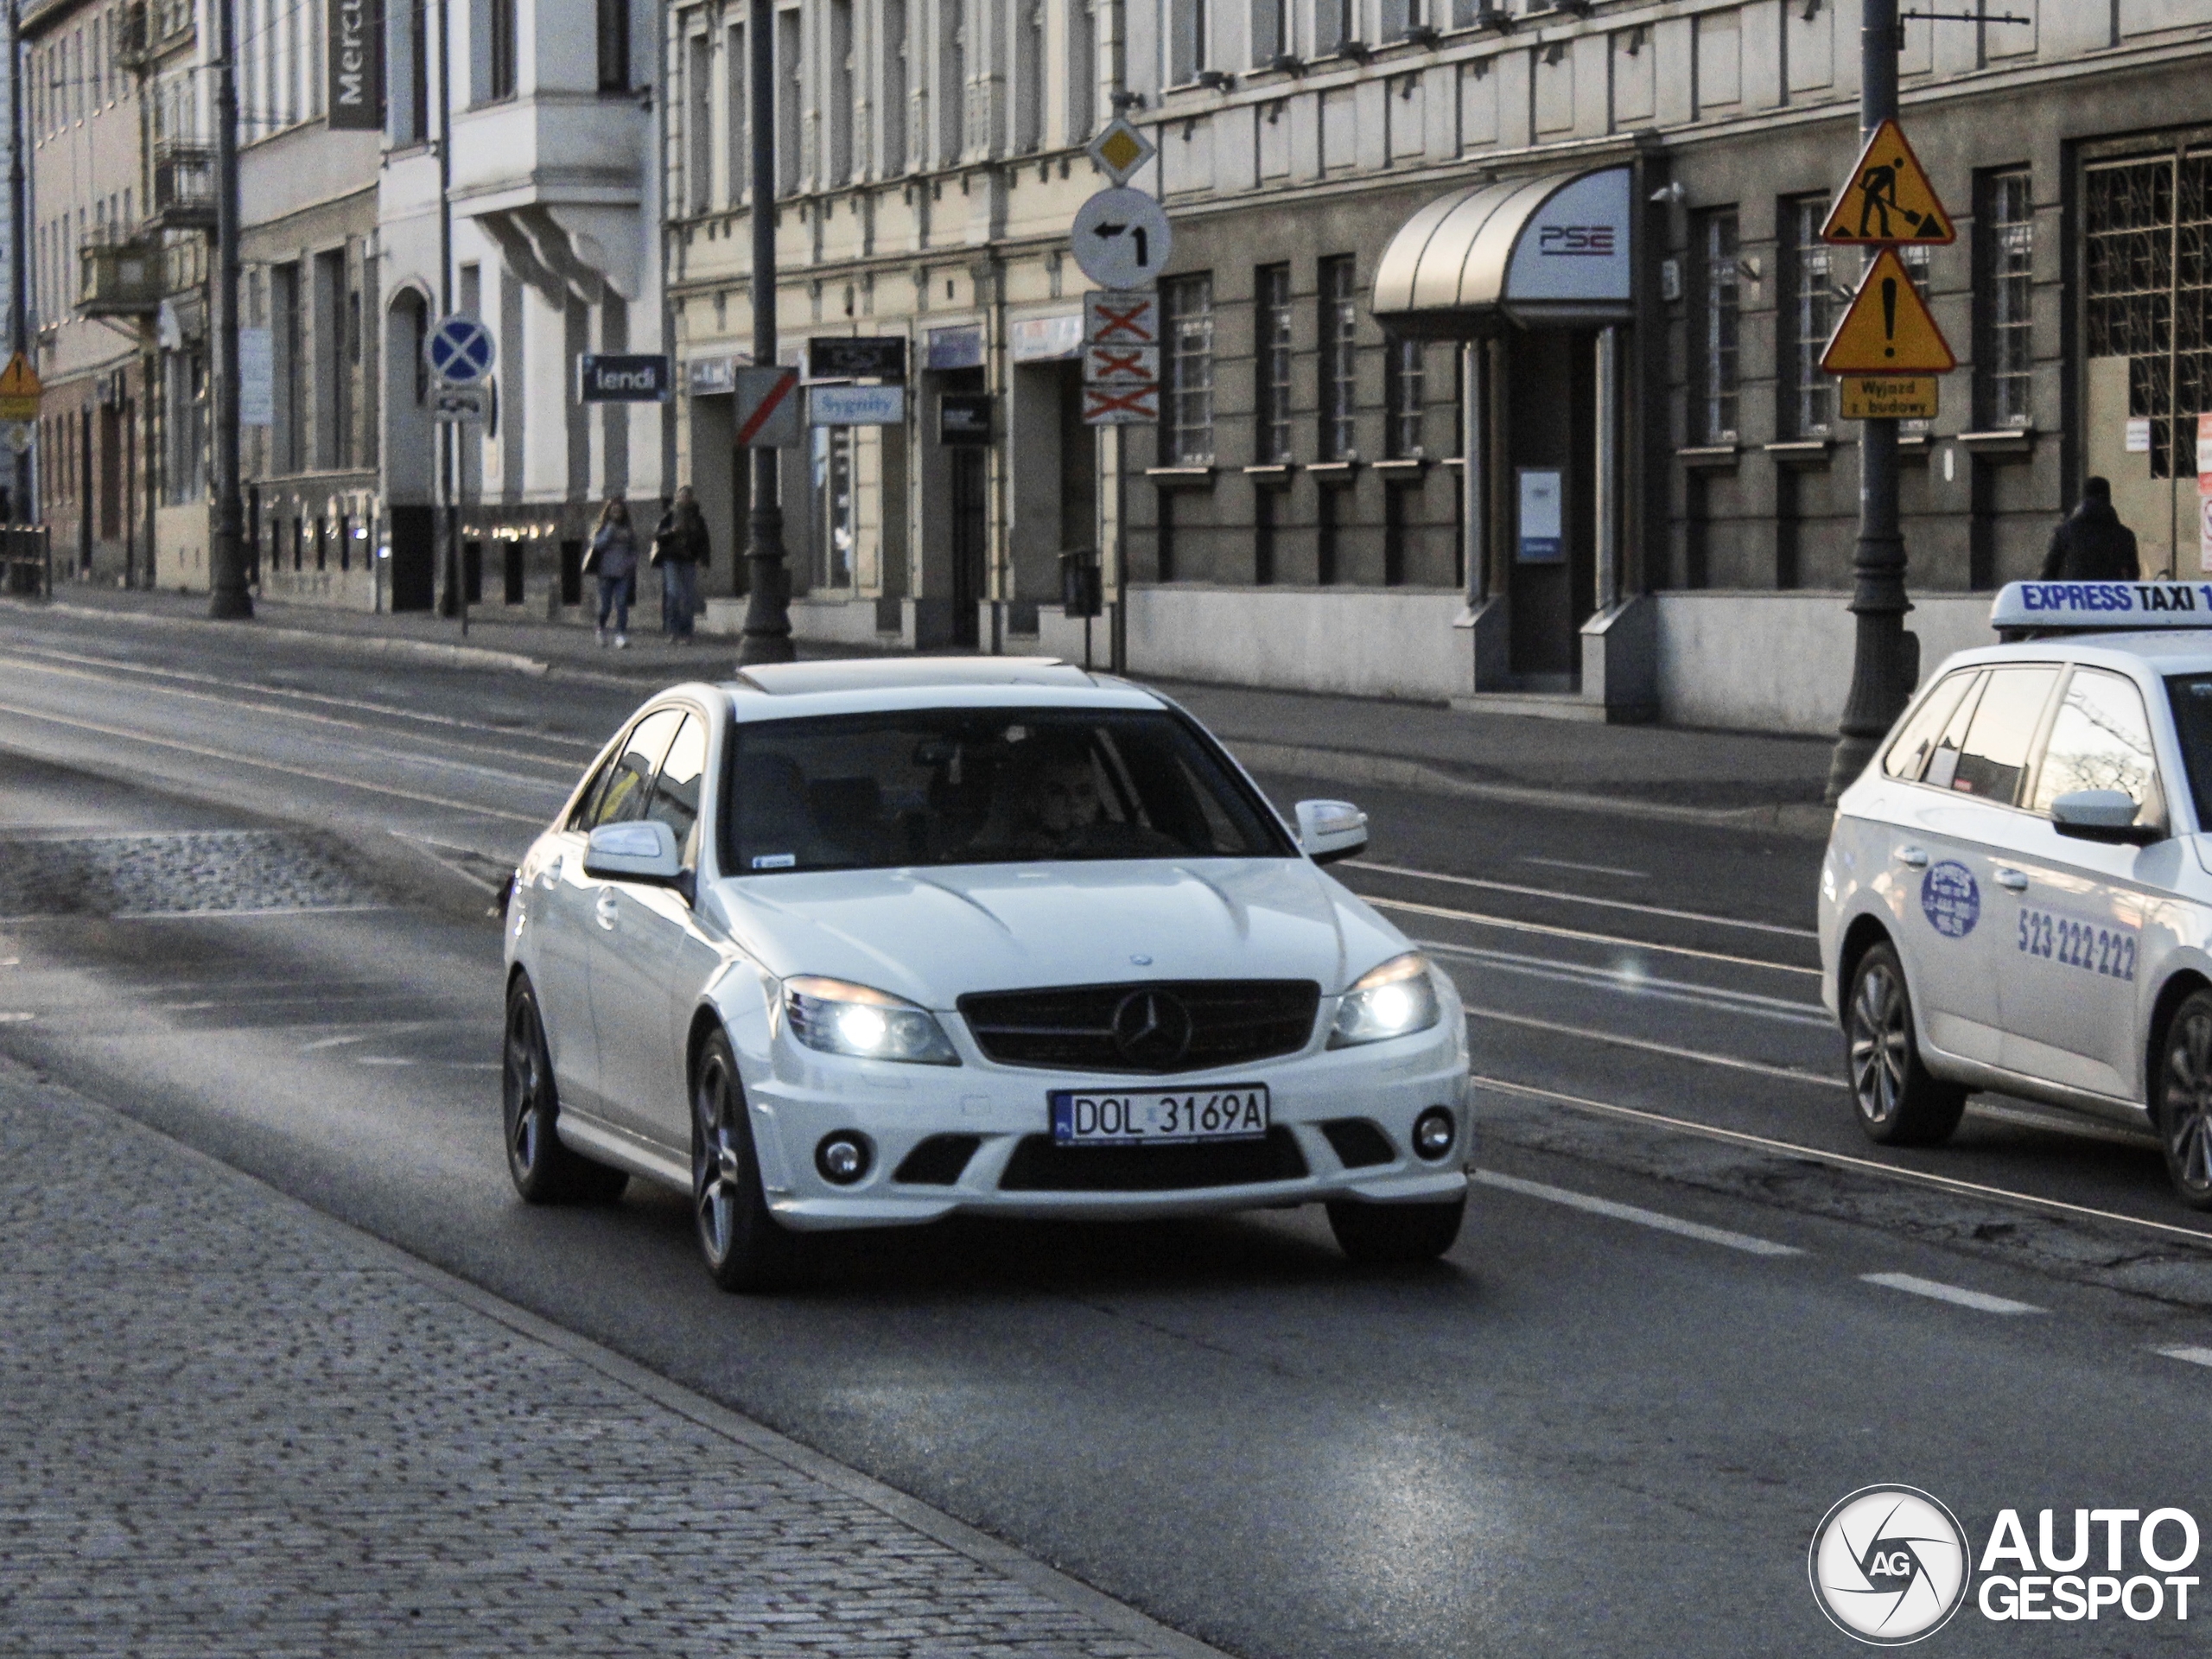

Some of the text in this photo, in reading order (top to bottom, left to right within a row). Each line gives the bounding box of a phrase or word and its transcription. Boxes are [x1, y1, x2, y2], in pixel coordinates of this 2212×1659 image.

[1540, 226, 1615, 248] PSE
[2021, 584, 2134, 612] EXPRESS
[2133, 585, 2196, 612] TAXI
[1075, 1092, 1263, 1135] DOL 3169A
